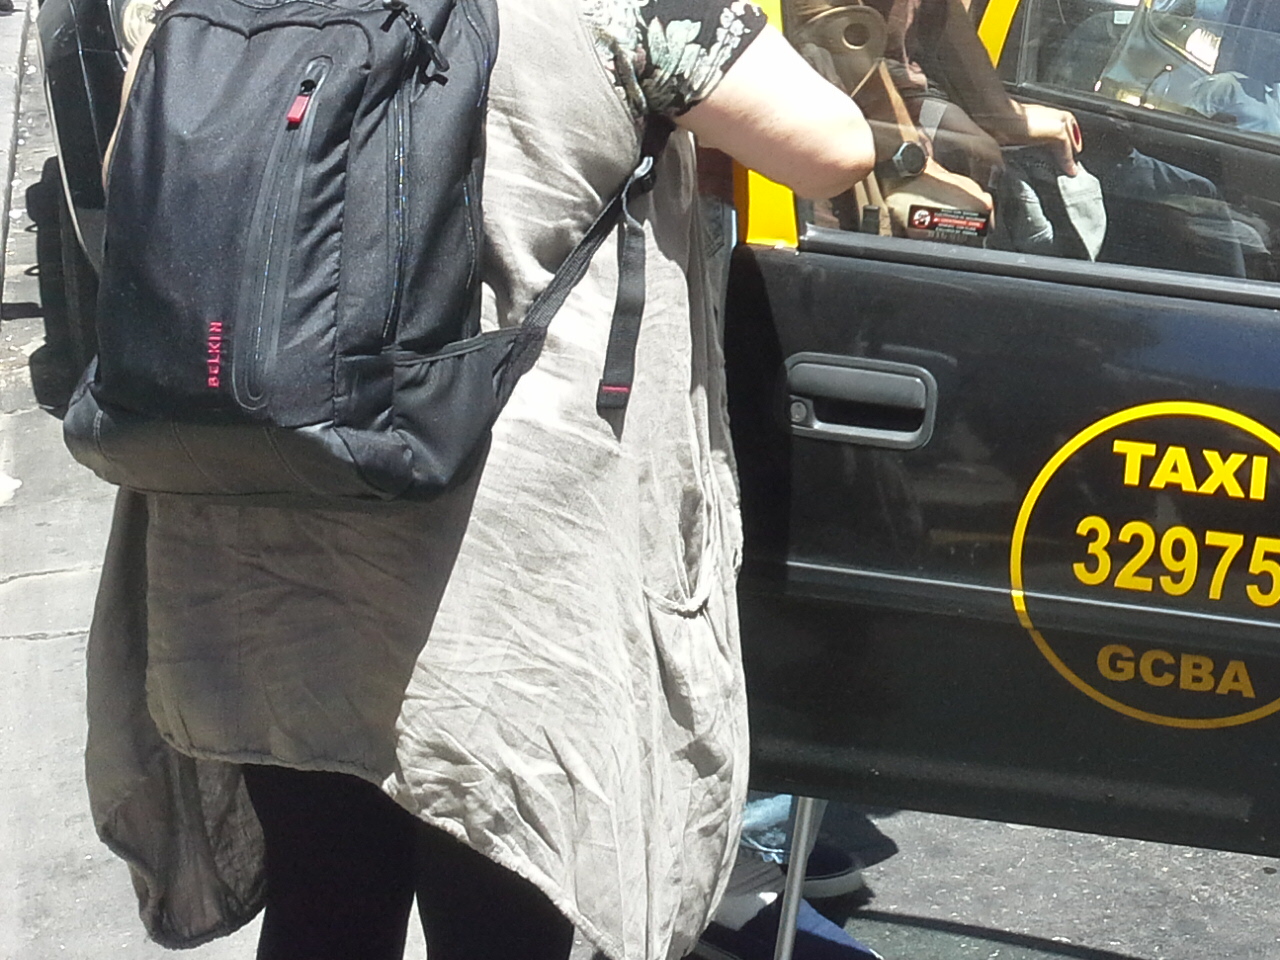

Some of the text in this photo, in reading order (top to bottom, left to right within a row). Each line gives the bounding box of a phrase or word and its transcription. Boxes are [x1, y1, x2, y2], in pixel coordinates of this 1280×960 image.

[207, 322, 222, 388] BELKIN
[1113, 440, 1268, 501] TAXI
[1097, 644, 1256, 700] GCBA
